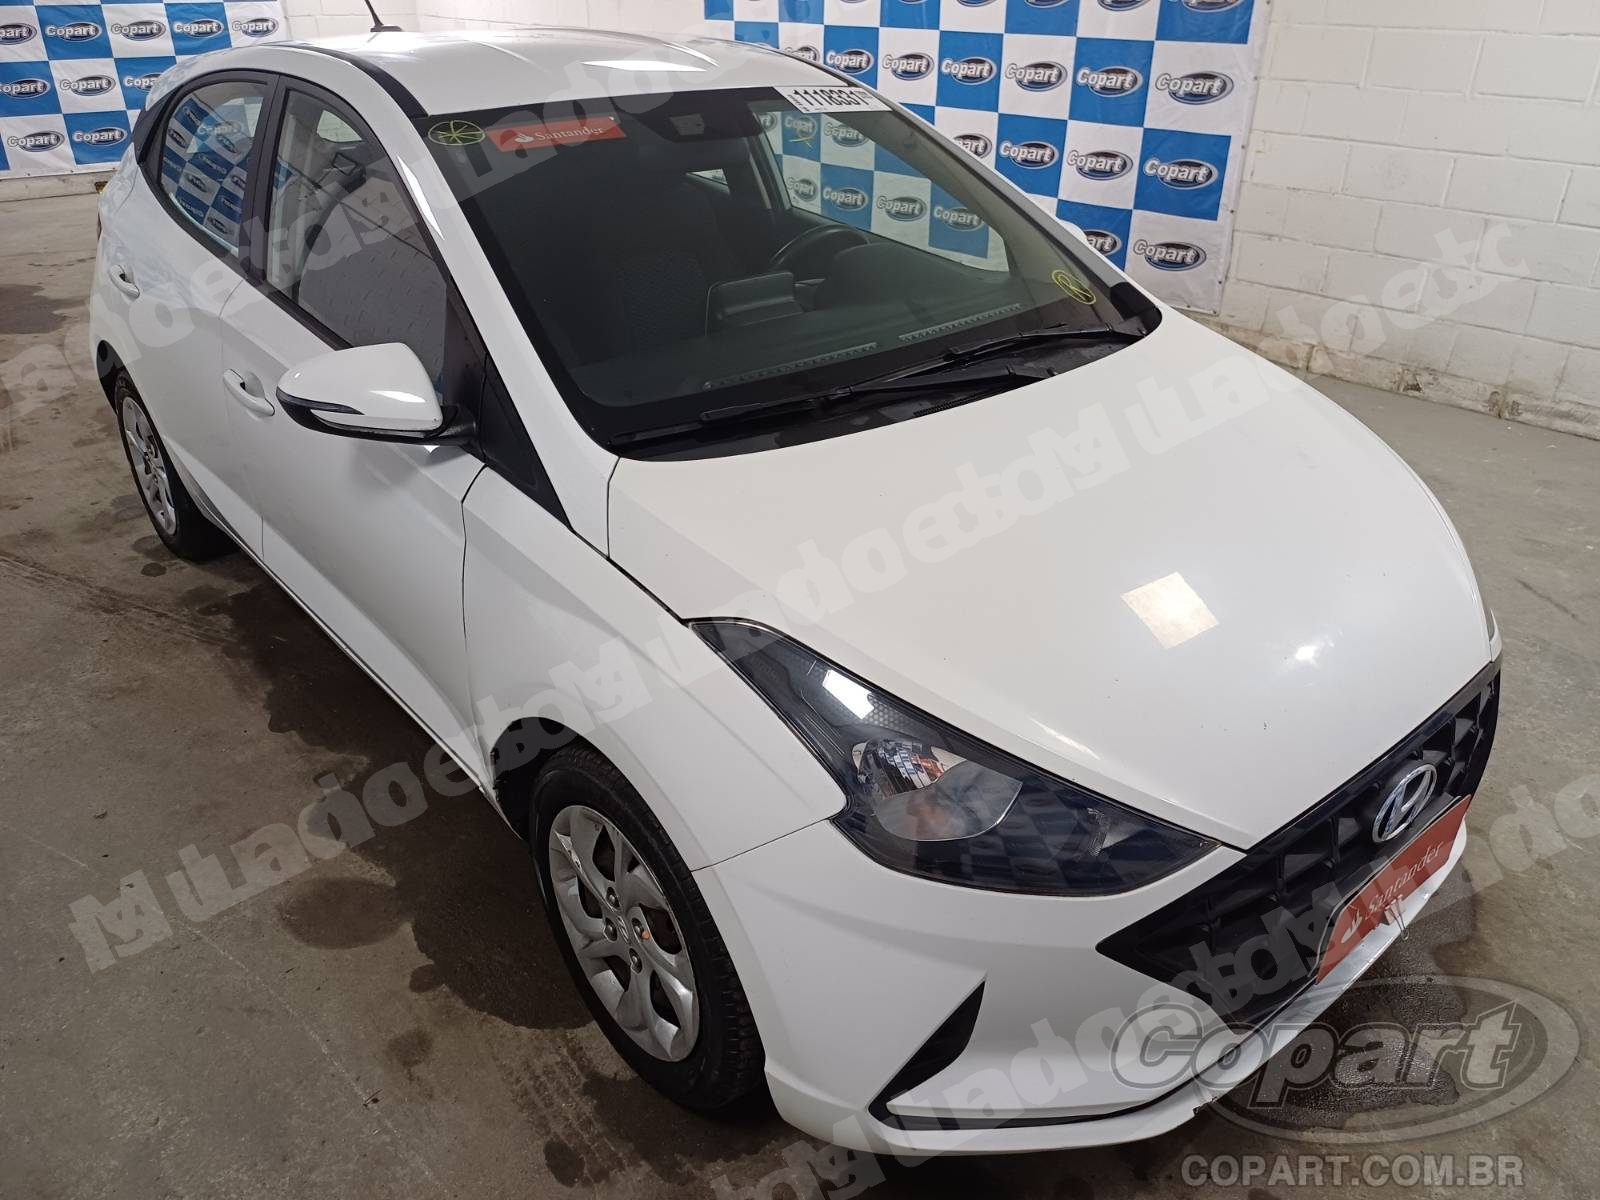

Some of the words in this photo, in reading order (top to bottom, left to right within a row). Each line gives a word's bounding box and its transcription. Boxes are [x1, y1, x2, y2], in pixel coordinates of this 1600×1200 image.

[0, 26, 28, 38] part
[46, 25, 96, 38] Copart
[112, 23, 158, 35] Copart
[174, 21, 218, 35] Copart
[233, 21, 274, 32] Copart
[826, 50, 868, 69] Copart
[882, 54, 927, 74] Copart
[941, 58, 990, 79] Copart
[1005, 63, 1059, 84] Copart
[1077, 67, 1133, 90] Copart
[0, 81, 43, 94] opart
[61, 77, 109, 90] Copart
[1155, 73, 1222, 97] Copart
[8, 134, 57, 147] Copart
[73, 129, 122, 142] Copart
[535, 126, 604, 140] Santander
[1000, 141, 1052, 163] Copart
[1067, 150, 1123, 173] Copart
[1144, 158, 1209, 182] Copart
[823, 187, 863, 205] Copart
[876, 196, 921, 215] Copart
[933, 206, 979, 226] Copart
[1087, 235, 1113, 251] art
[1133, 239, 1197, 264] Copart
